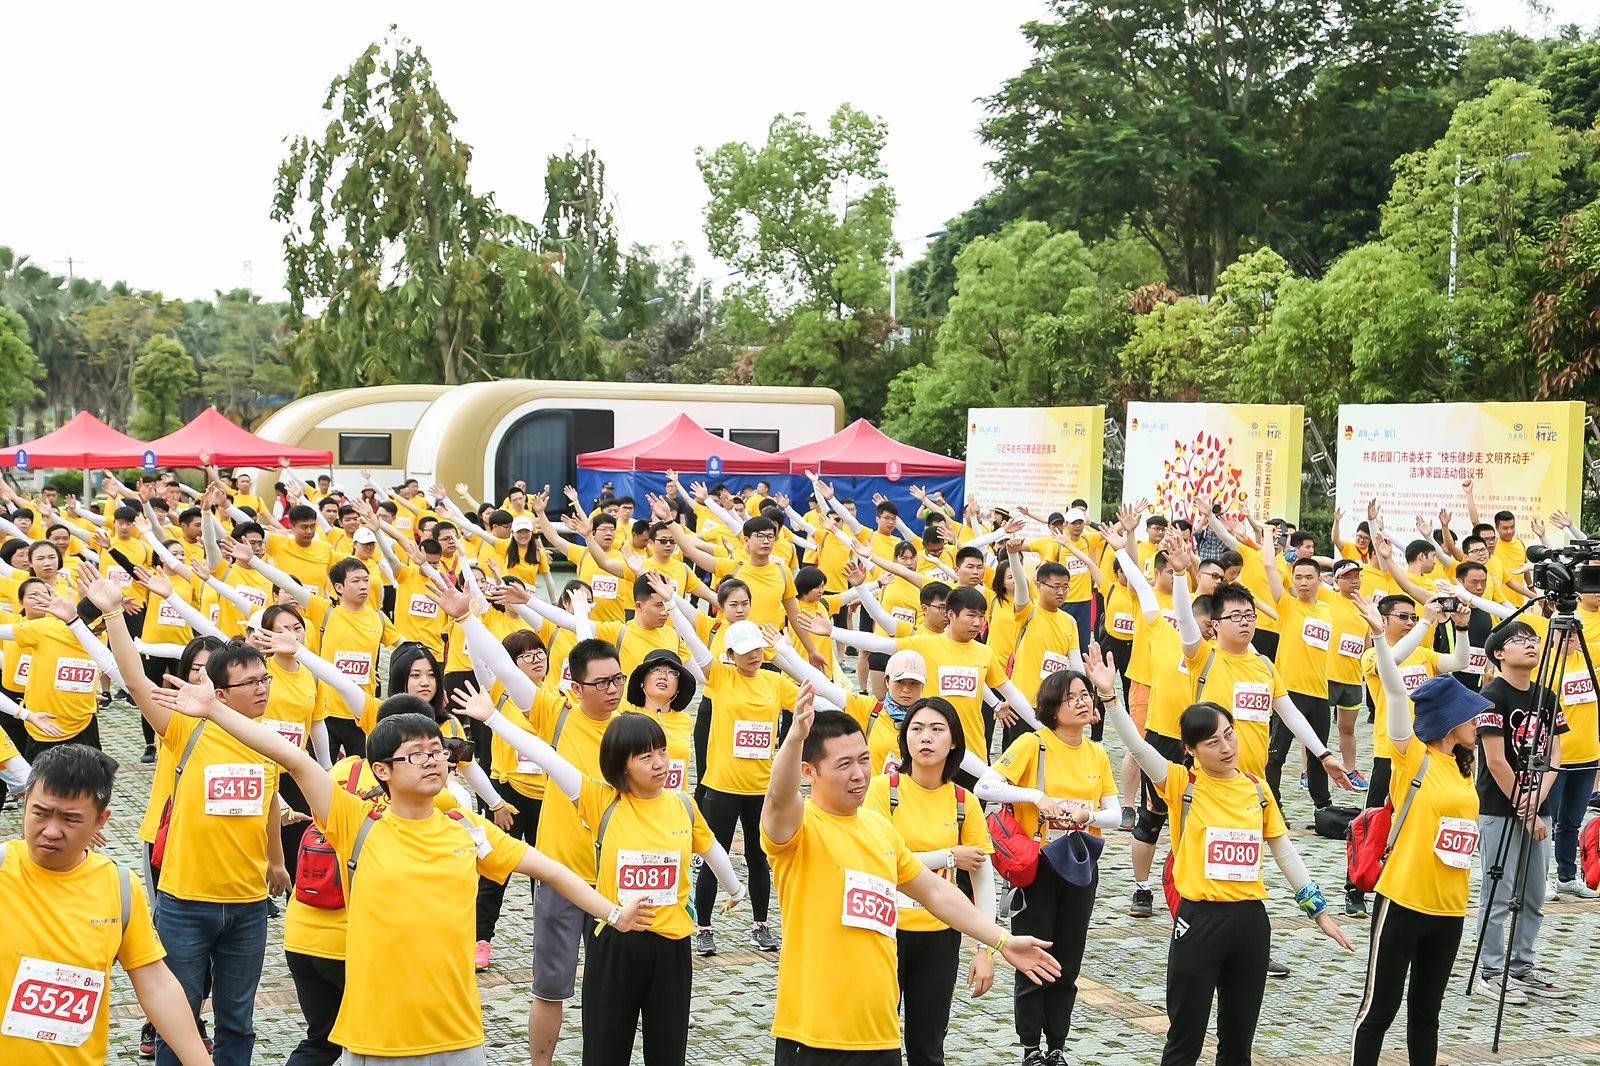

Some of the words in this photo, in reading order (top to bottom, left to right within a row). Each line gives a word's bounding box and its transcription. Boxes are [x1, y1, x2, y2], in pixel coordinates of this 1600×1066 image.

[1409, 466, 1484, 479] 洁净家园活动倡议书
[594, 581, 616, 592] 5302
[413, 601, 436, 613] 5424
[1306, 626, 1330, 641] 5418
[1342, 640, 1362, 654] 5274
[61, 667, 92, 682] 5112
[337, 661, 368, 674] 5407
[944, 676, 974, 690] 5290
[1567, 679, 1593, 694] 5430
[1239, 693, 1269, 709] 5282
[739, 732, 769, 747] 5355
[213, 779, 258, 798] 5415
[1212, 843, 1255, 864] 5080
[623, 868, 670, 888] 5081
[852, 891, 892, 922] 5527
[83, 977, 102, 990] 8km
[20, 984, 90, 1020] 5524
[37, 1032, 56, 1041] 5524
